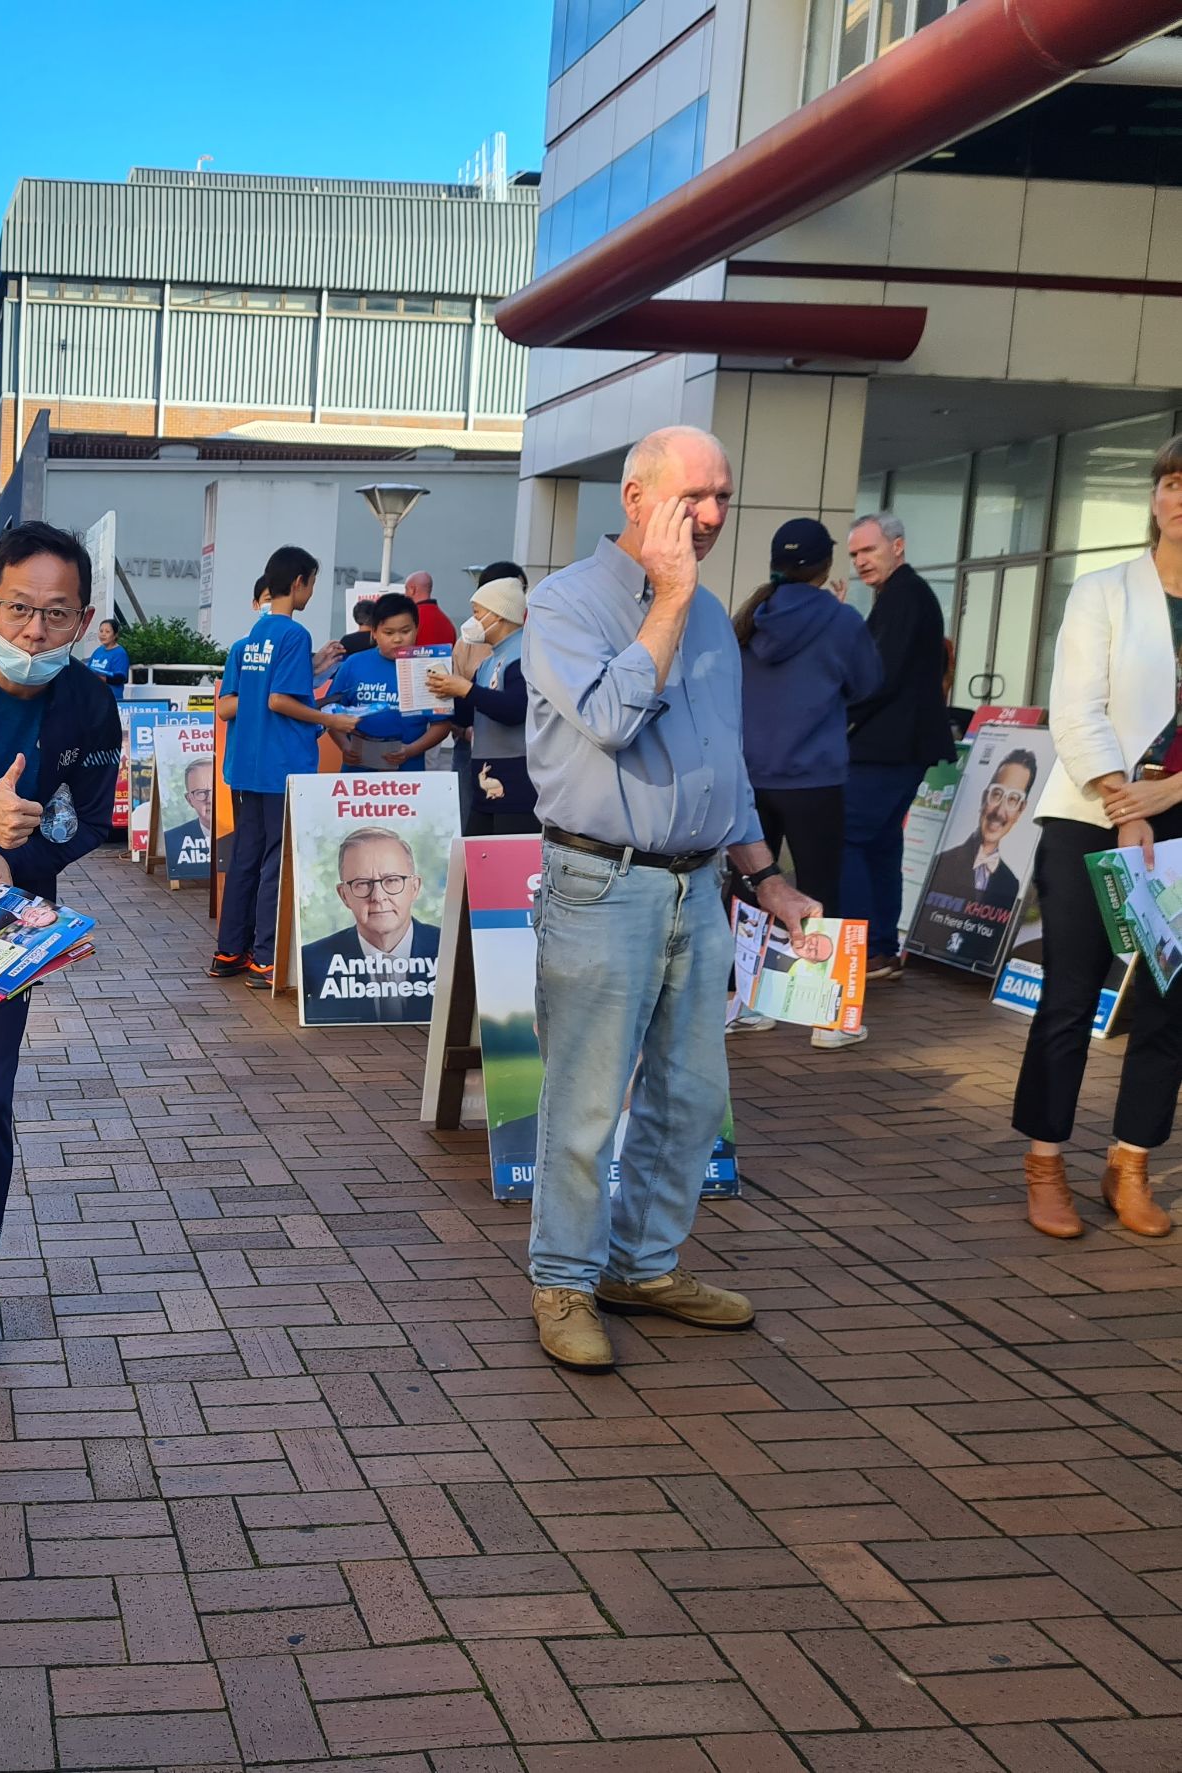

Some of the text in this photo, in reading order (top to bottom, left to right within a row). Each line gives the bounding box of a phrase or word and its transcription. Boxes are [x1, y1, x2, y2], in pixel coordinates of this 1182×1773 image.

[357, 682, 387, 692] David
[178, 730, 189, 740] A
[331, 779, 421, 797] A Better
[337, 800, 417, 817] Future.
[977, 922, 994, 937] You
[327, 952, 439, 978] Anthony
[847, 956, 858, 999] POLLARD
[319, 976, 437, 999] Albanese
